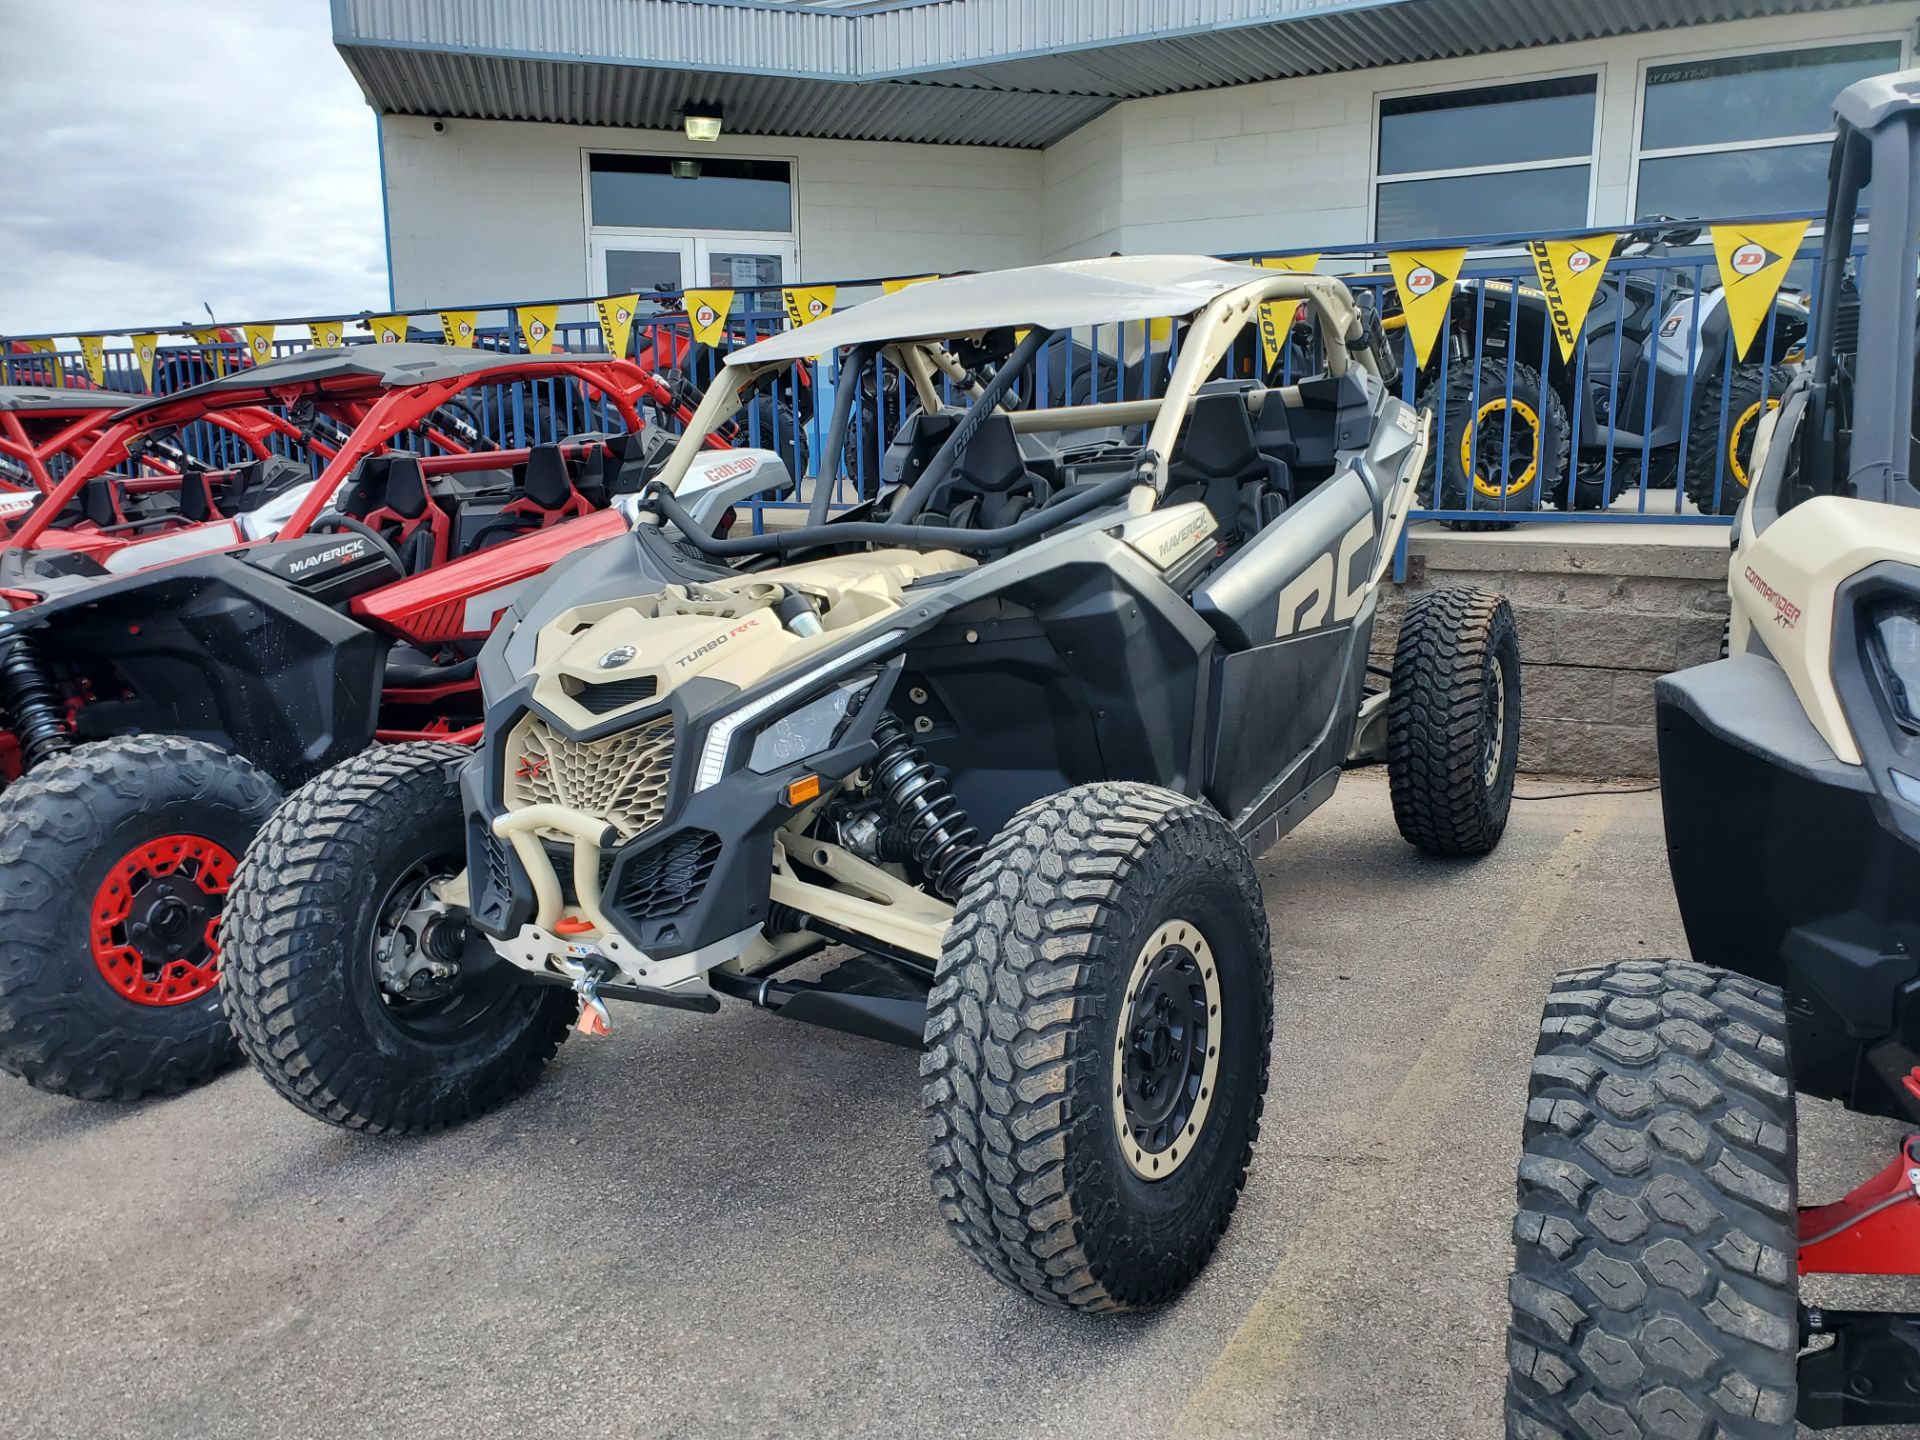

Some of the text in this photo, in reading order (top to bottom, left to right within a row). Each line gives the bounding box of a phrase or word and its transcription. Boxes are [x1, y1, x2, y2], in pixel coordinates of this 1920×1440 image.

[1573, 257, 1588, 266] D
[1736, 253, 1763, 266] D
[1410, 275, 1432, 287] D
[1532, 240, 1574, 345] DUNLOP
[700, 312, 712, 320] D
[953, 387, 1001, 458] can-am
[704, 457, 757, 483] can-am
[1158, 512, 1207, 557] MAVERICK
[289, 539, 365, 573] MAVERICK
[1744, 565, 1802, 624] COMMANDER
[676, 619, 760, 668] TURBO RR
